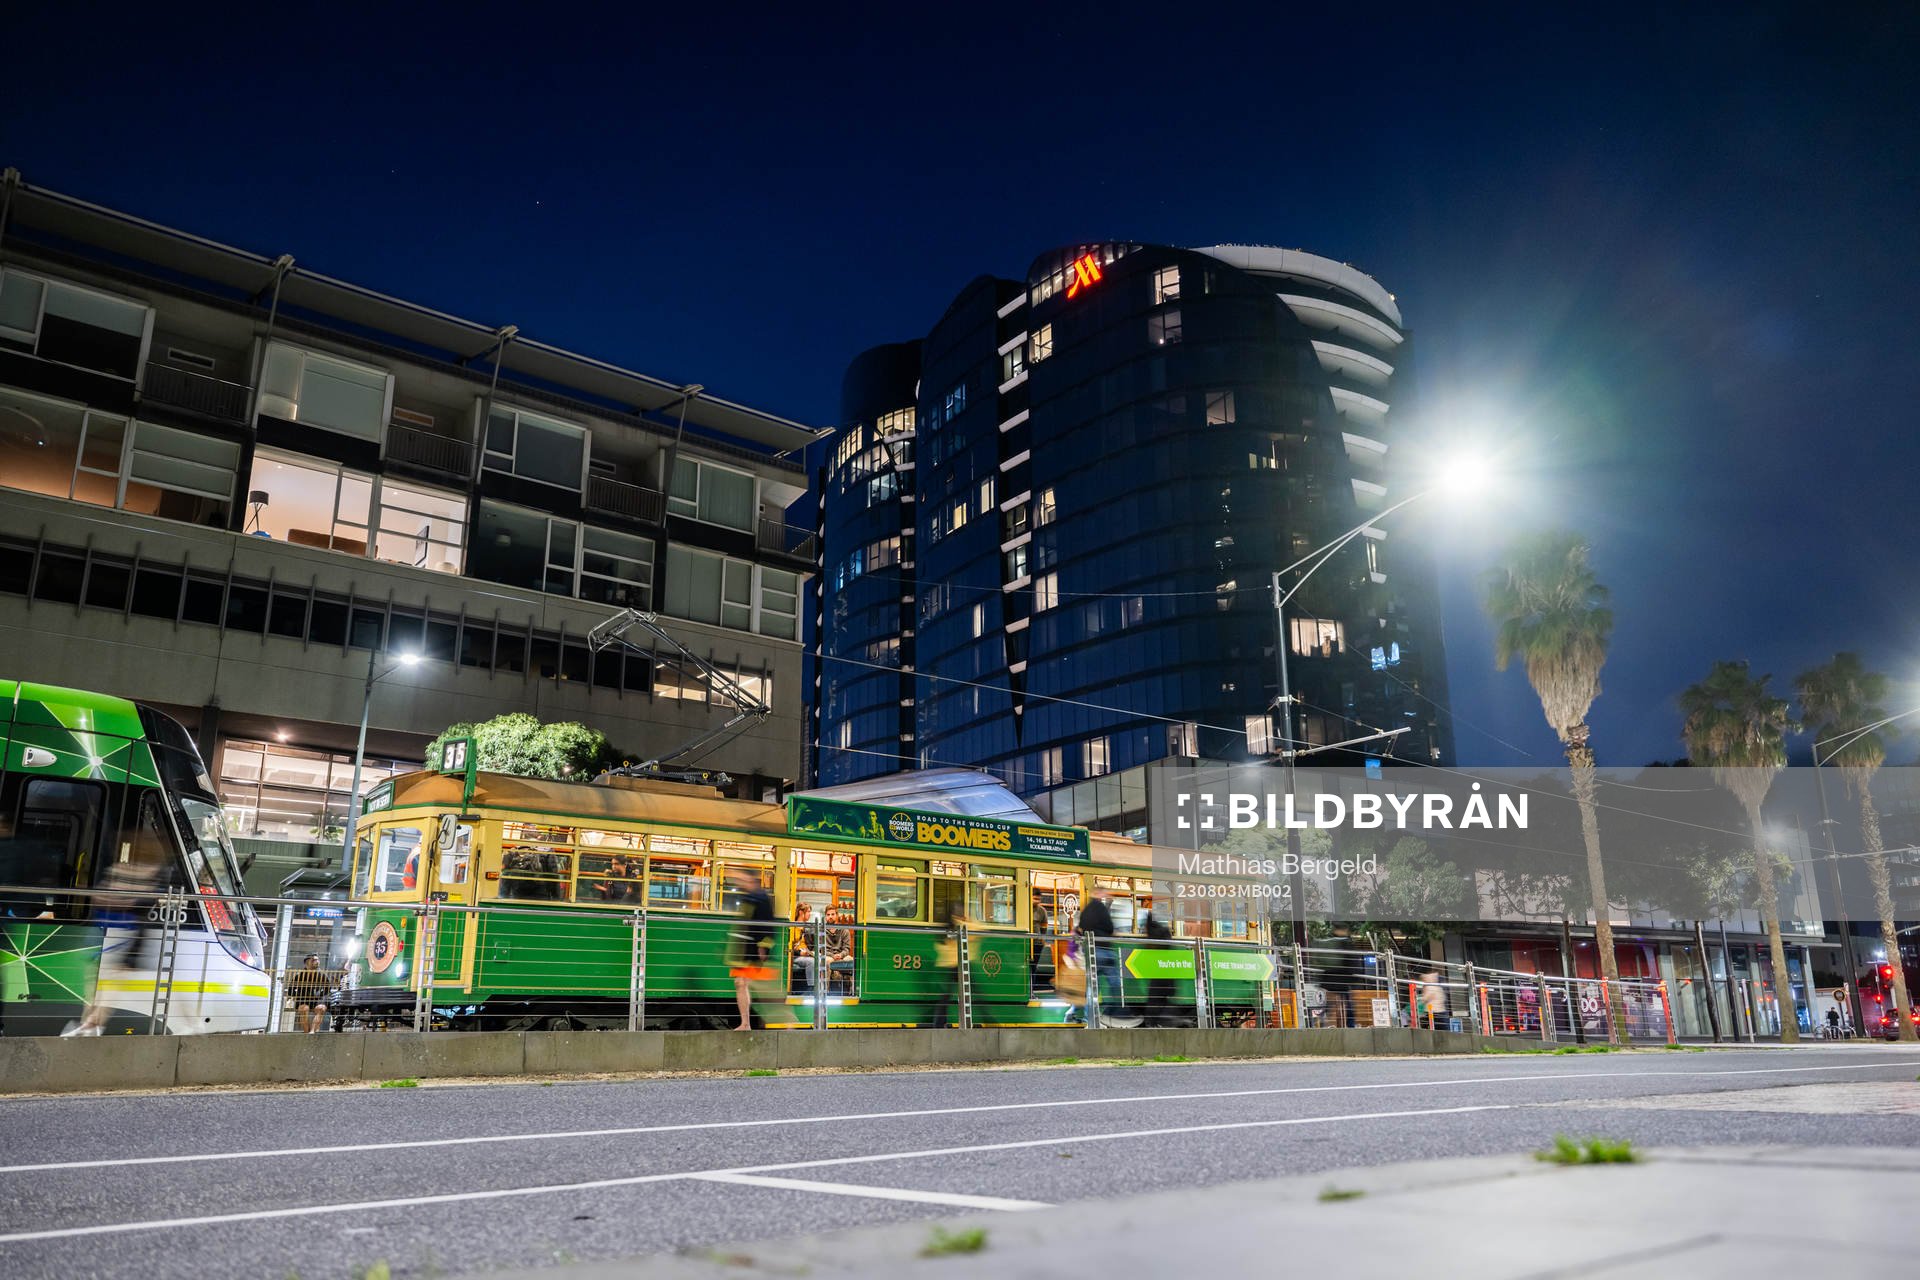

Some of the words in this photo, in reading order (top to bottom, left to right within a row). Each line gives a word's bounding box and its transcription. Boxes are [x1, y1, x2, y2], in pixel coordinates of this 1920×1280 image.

[444, 742, 467, 770] 35
[889, 818, 914, 827] BOOMERS
[896, 824, 914, 833] WORLD
[916, 815, 937, 823] ROAD
[969, 821, 994, 829] WORLD
[917, 822, 1012, 851] BOOMERS
[375, 941, 387, 954] 35
[892, 954, 922, 970] 928
[1157, 959, 1175, 968] You're
[1175, 960, 1181, 968] in
[1181, 960, 1192, 968] the
